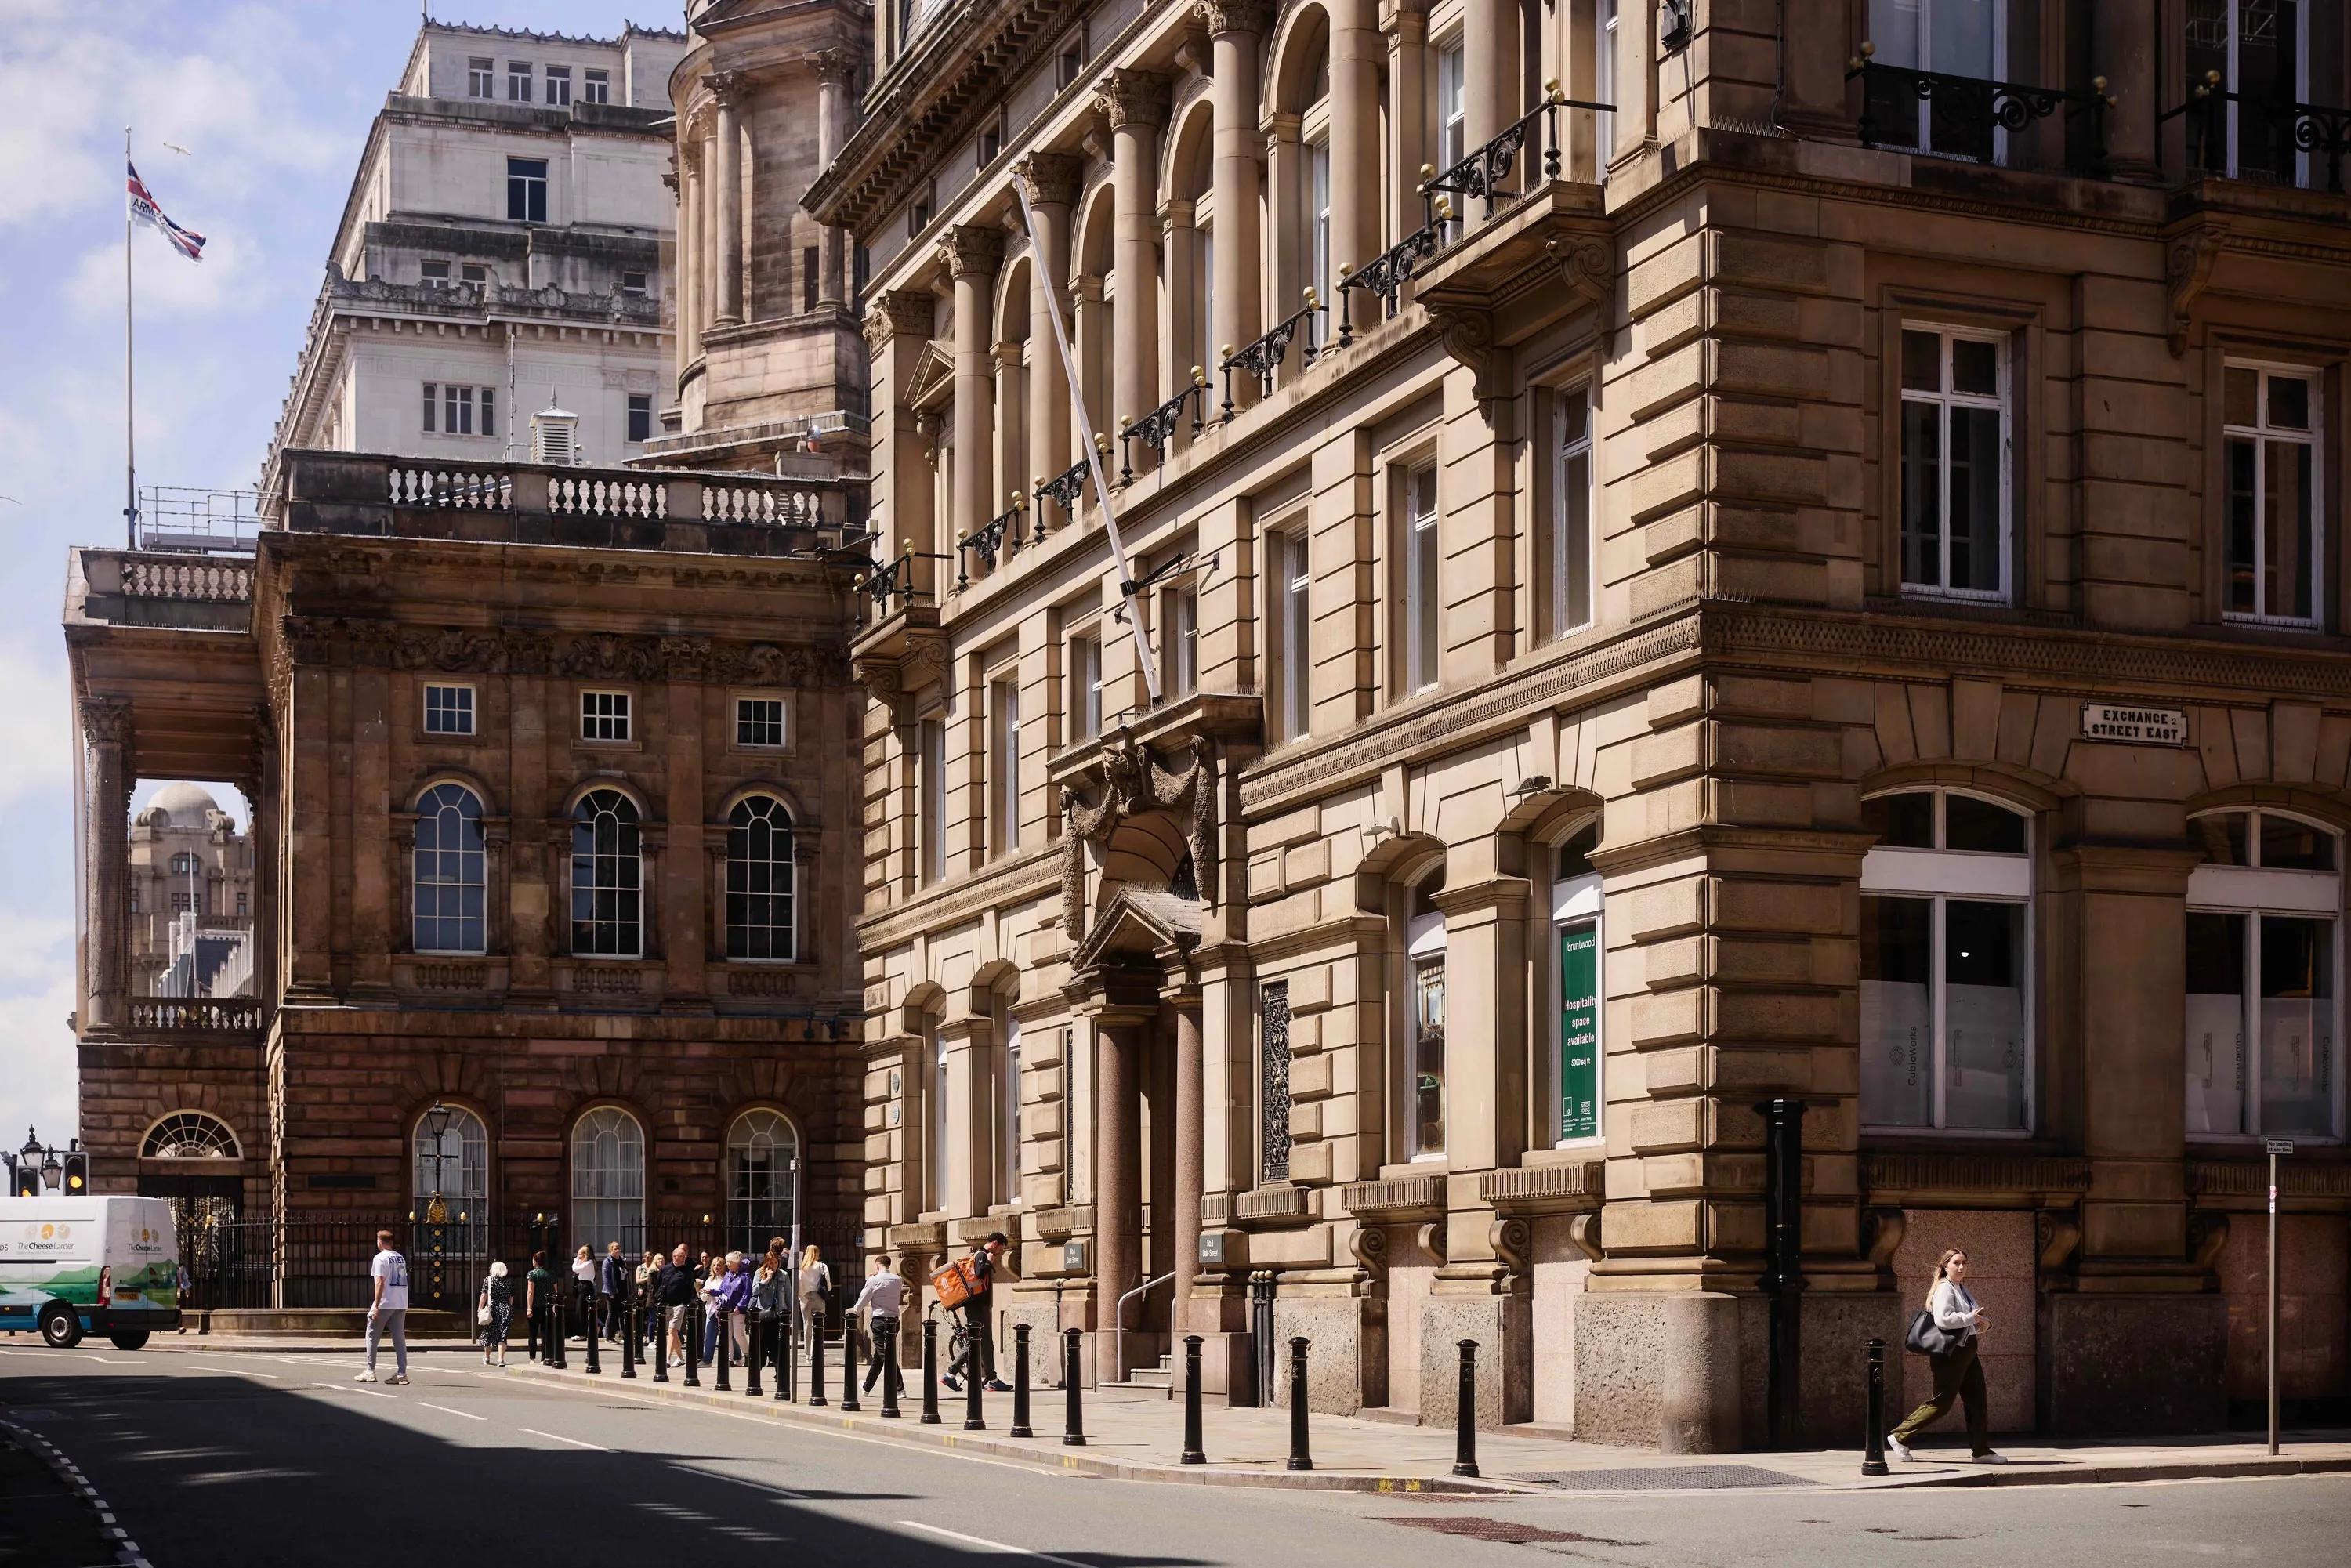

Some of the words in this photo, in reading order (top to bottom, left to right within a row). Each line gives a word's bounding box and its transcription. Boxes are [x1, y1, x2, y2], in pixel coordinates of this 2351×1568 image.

[2103, 709, 2168, 725] EXCHANGE
[2092, 724, 2140, 737] STREET
[2146, 727, 2179, 740] EAST
[1567, 936, 1596, 952] bruntwood
[1565, 995, 1596, 1011] Hospitality
[1571, 1016, 1590, 1029] space
[1567, 1032, 1595, 1046] available
[1571, 1058, 1581, 1067] 5000
[1581, 1058, 1587, 1066] sq
[1907, 1026, 1918, 1086] CubicWorks
[387, 1255, 405, 1264] NIKE
